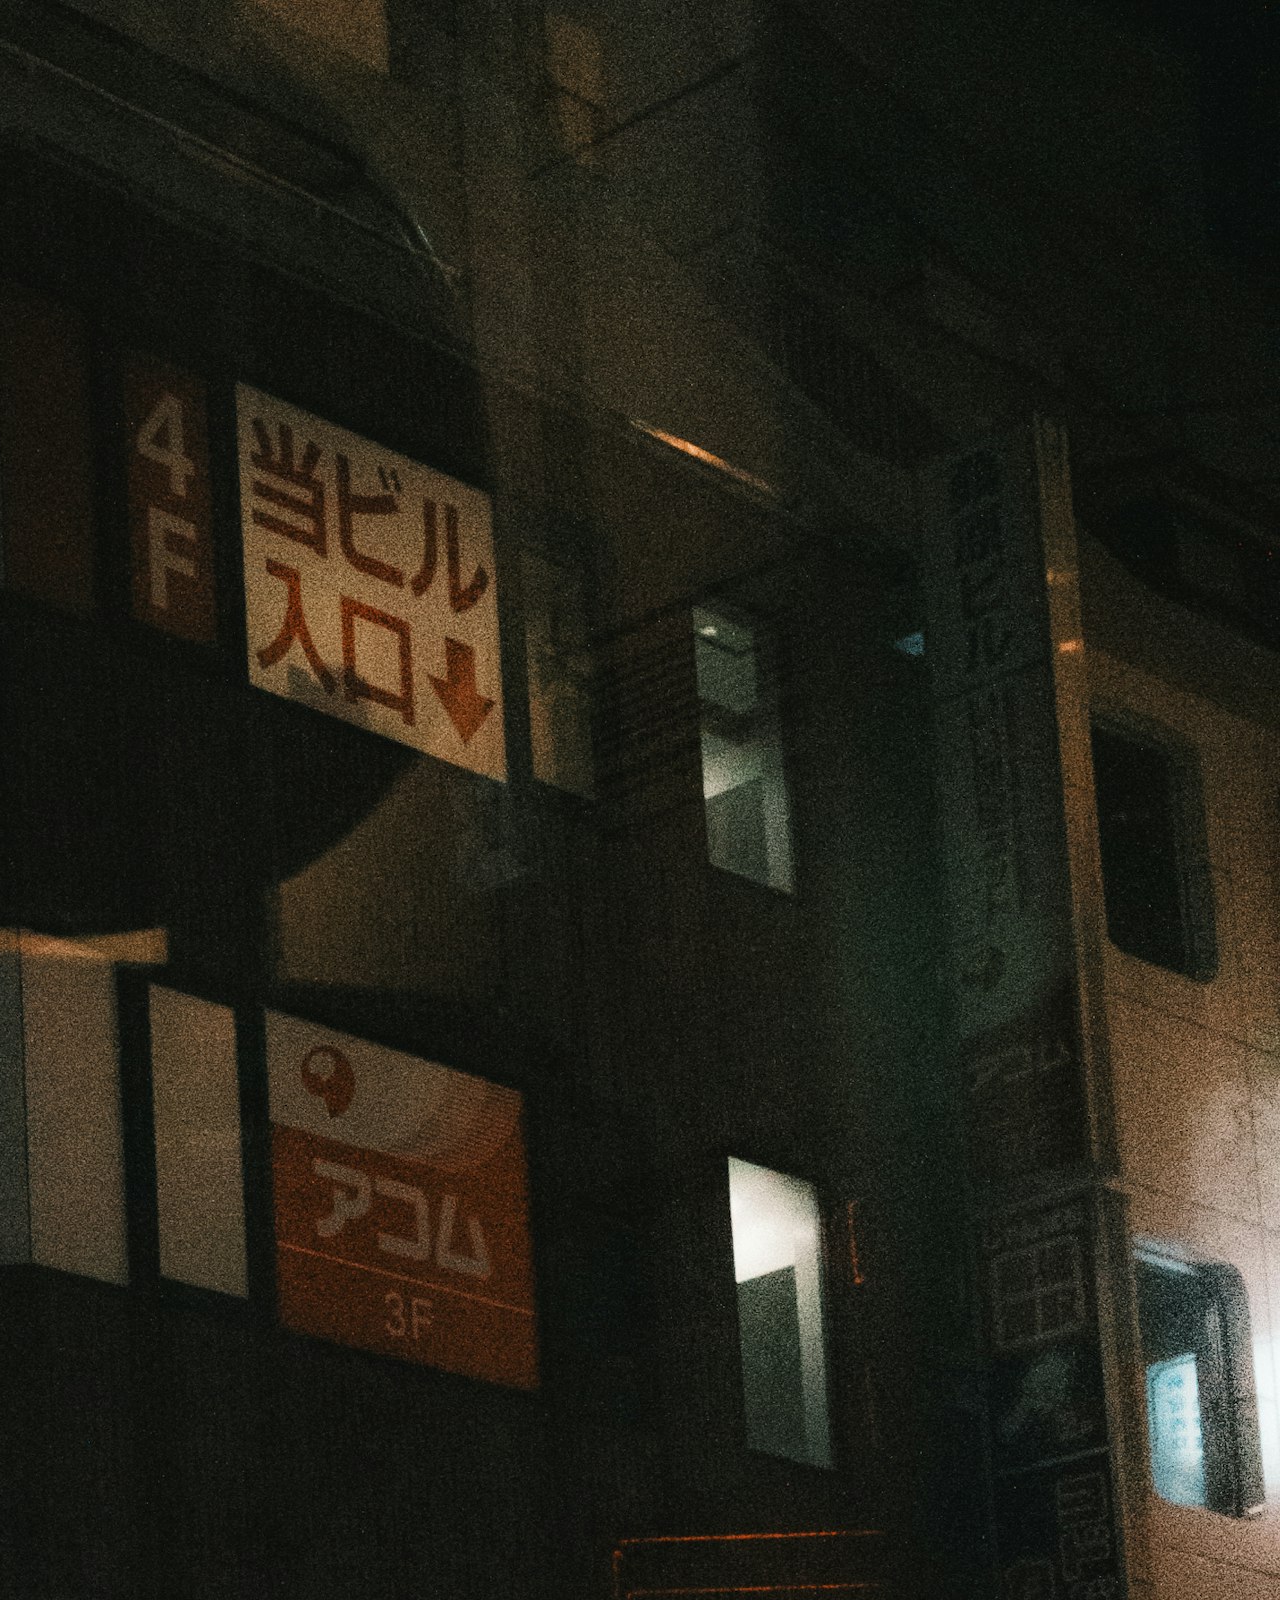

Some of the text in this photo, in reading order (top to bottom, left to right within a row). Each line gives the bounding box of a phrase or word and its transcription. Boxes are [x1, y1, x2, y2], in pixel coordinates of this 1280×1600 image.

[138, 391, 200, 611] 4F
[251, 418, 489, 613] 当ビル
[255, 558, 416, 726] 入口
[312, 1157, 493, 1281] アコム
[383, 1293, 435, 1340] 3F
